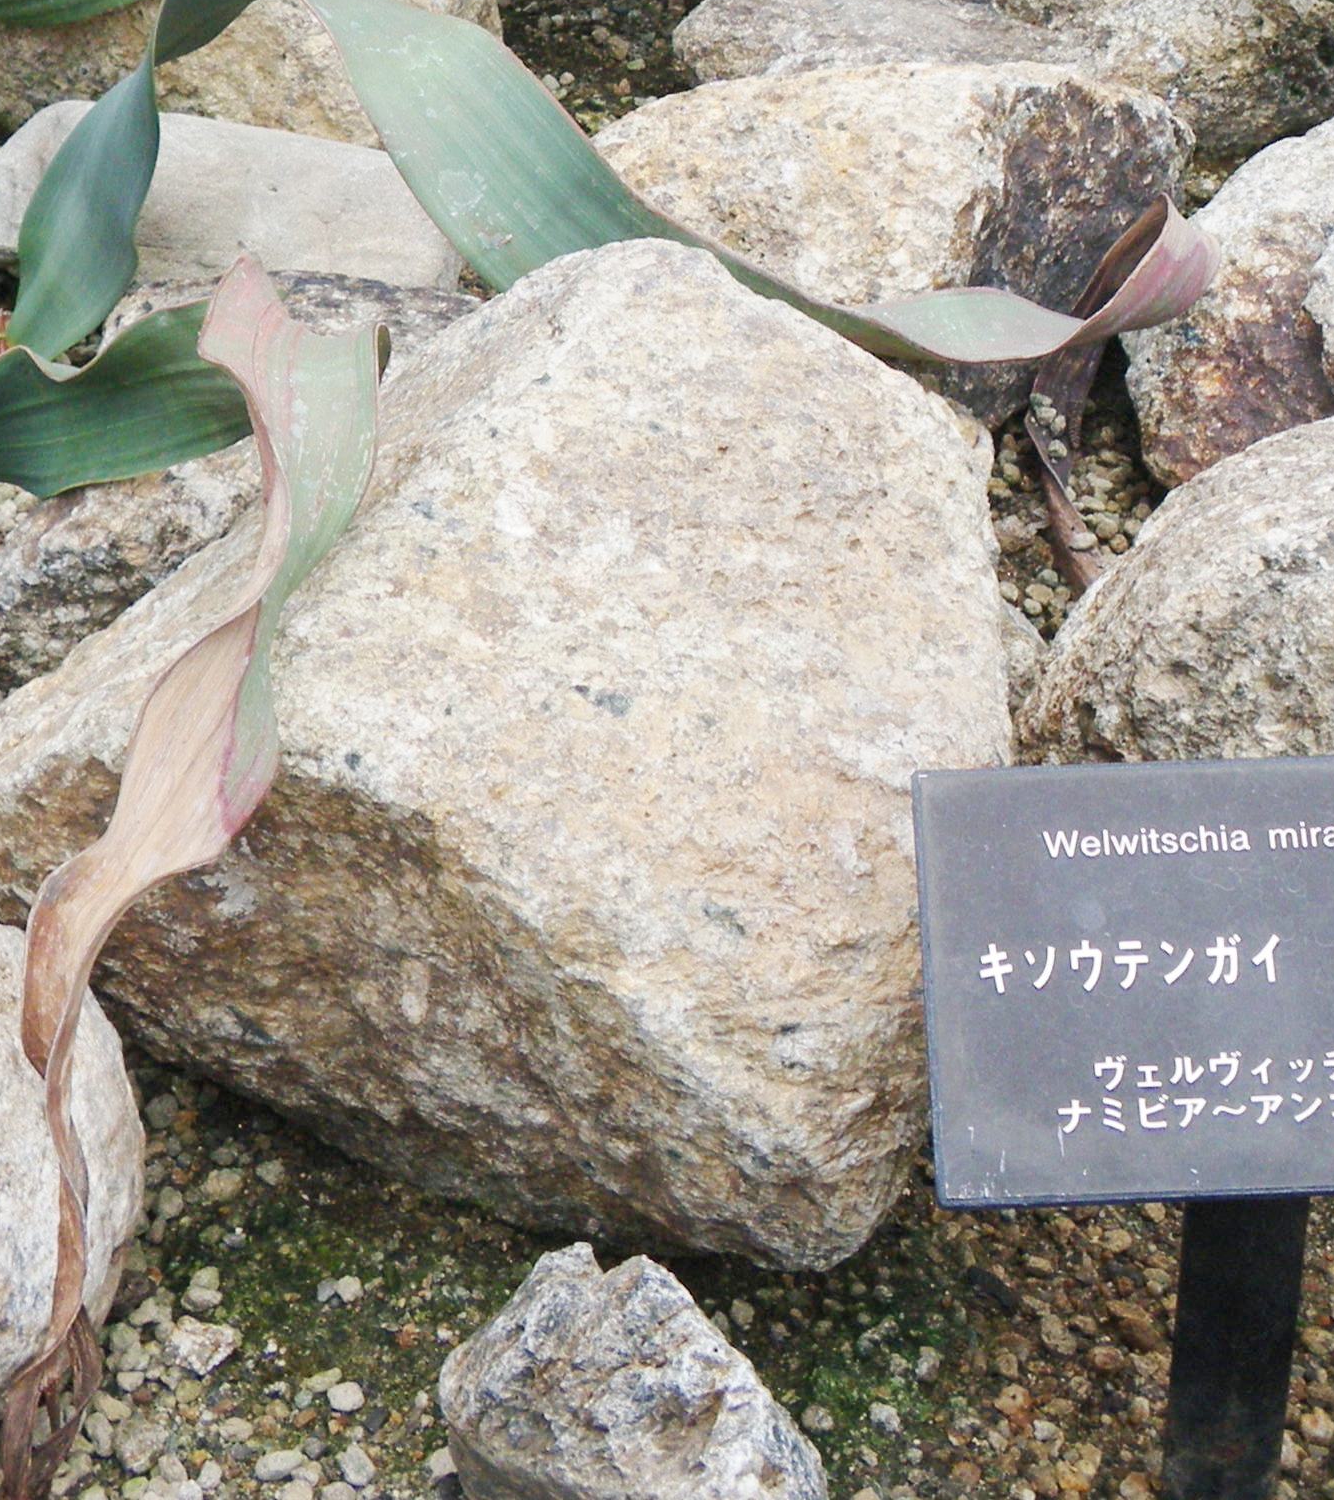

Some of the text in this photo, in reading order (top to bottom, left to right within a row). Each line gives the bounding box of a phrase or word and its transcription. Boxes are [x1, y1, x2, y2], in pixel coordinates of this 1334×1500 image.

[1042, 824, 1251, 859] Welwitschia
[978, 932, 1282, 995] キソウテンガイ
